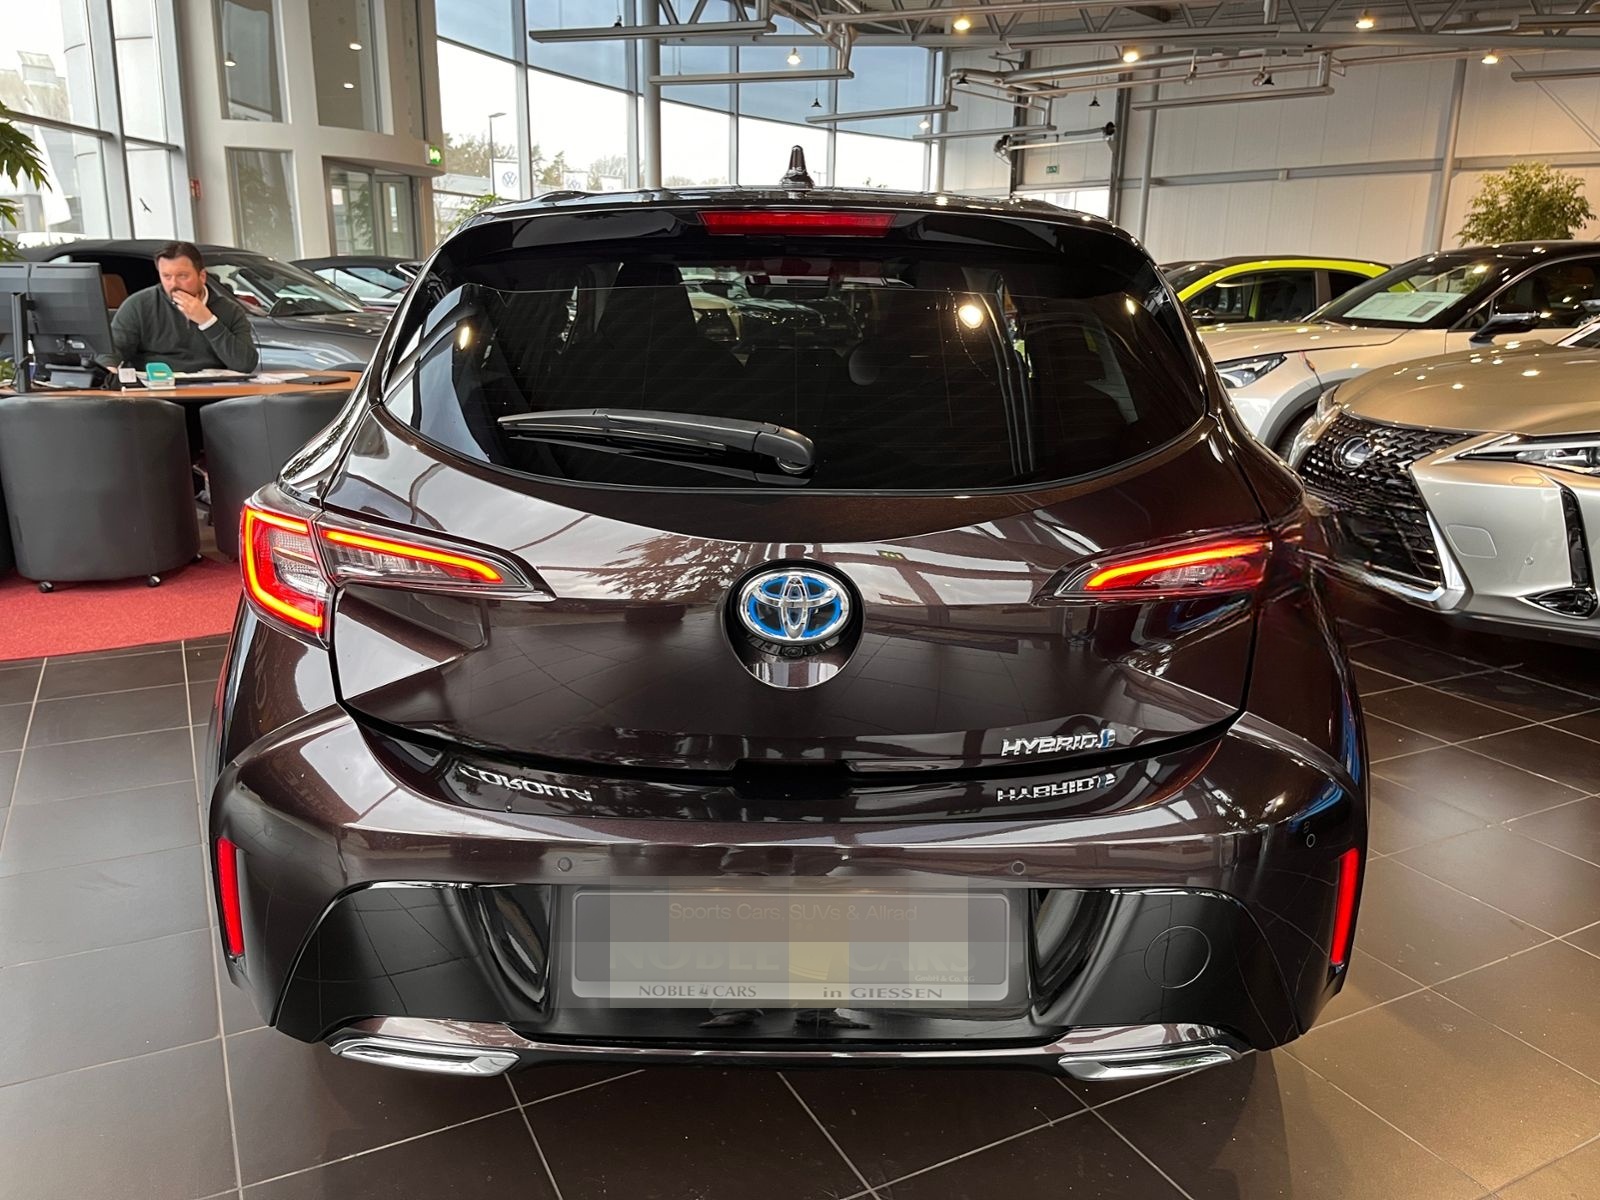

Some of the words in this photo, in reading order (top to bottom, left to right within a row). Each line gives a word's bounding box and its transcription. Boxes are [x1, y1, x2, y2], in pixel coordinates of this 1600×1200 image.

[1001, 734, 1098, 756] HYBRID
[669, 903, 731, 923] Sports
[789, 904, 841, 920] SUVs
[847, 904, 861, 920] &
[865, 903, 917, 920] Allrad
[638, 985, 695, 997] NOBLE
[713, 985, 757, 998] CARS
[823, 986, 841, 998] in
[850, 986, 943, 999] GIESSEN
